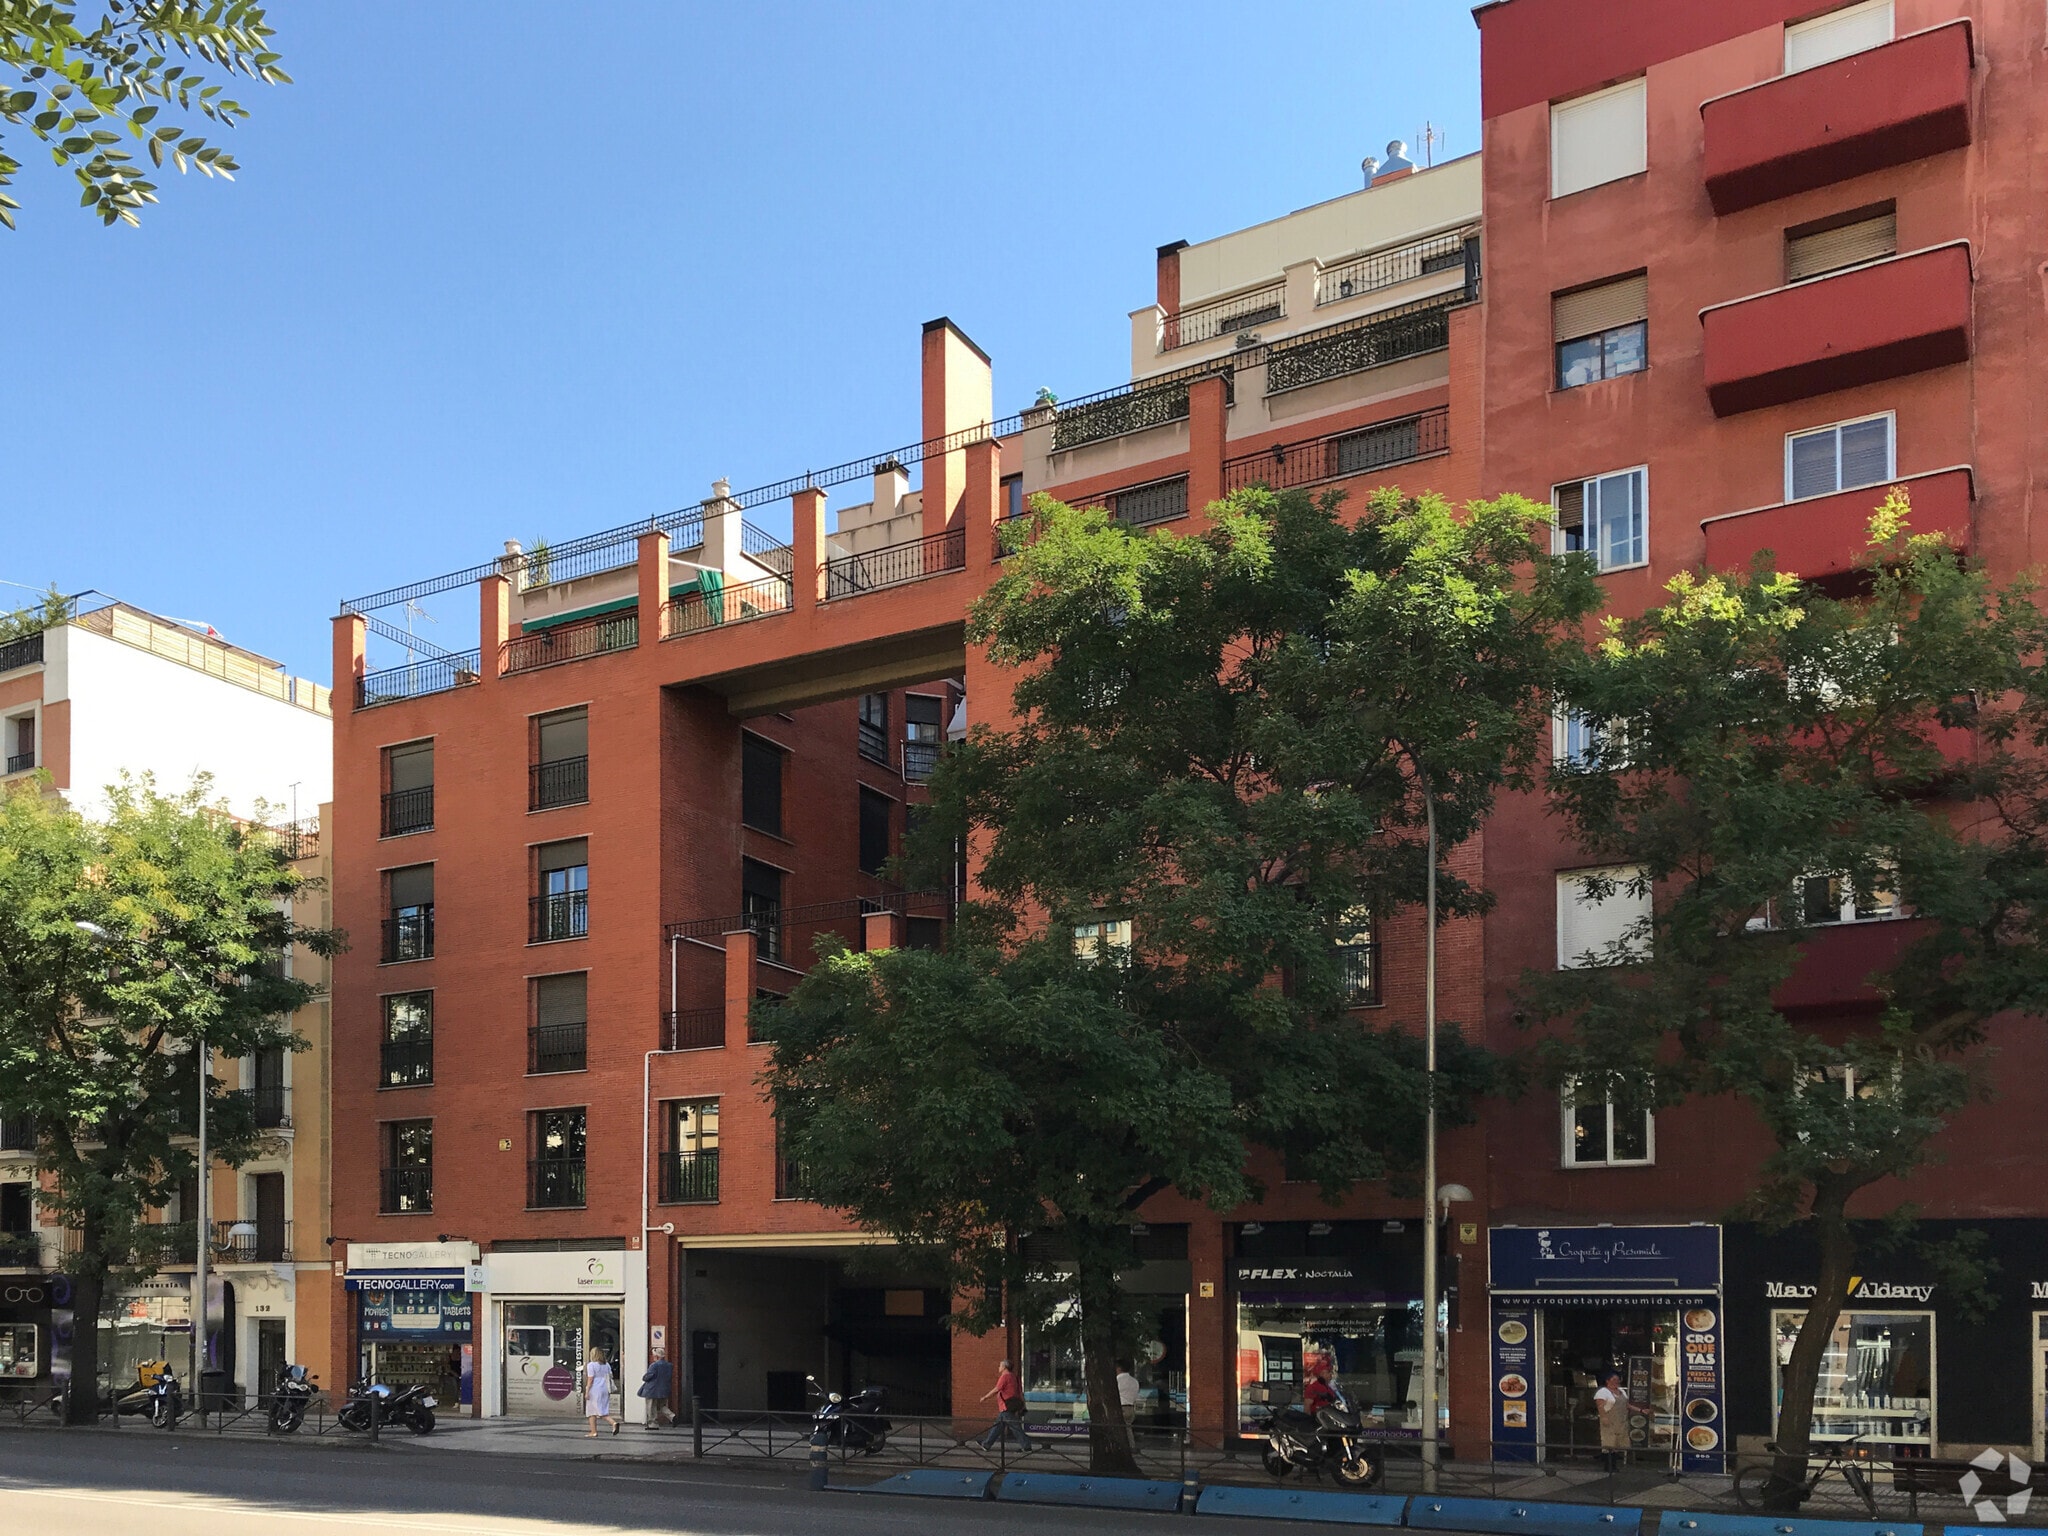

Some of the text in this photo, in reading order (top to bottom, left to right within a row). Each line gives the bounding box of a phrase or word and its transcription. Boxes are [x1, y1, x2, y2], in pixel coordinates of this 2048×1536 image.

[383, 1250, 453, 1260] TECNOGALLERY
[1250, 1268, 1298, 1280] FLEX
[357, 1279, 455, 1290] TECNOGALLERY.com
[1855, 1281, 1934, 1302] Aldany
[256, 1305, 271, 1313] 132
[1685, 1334, 1715, 1344] CRO
[1685, 1343, 1716, 1354] QUE
[1686, 1353, 1716, 1365] TAS
